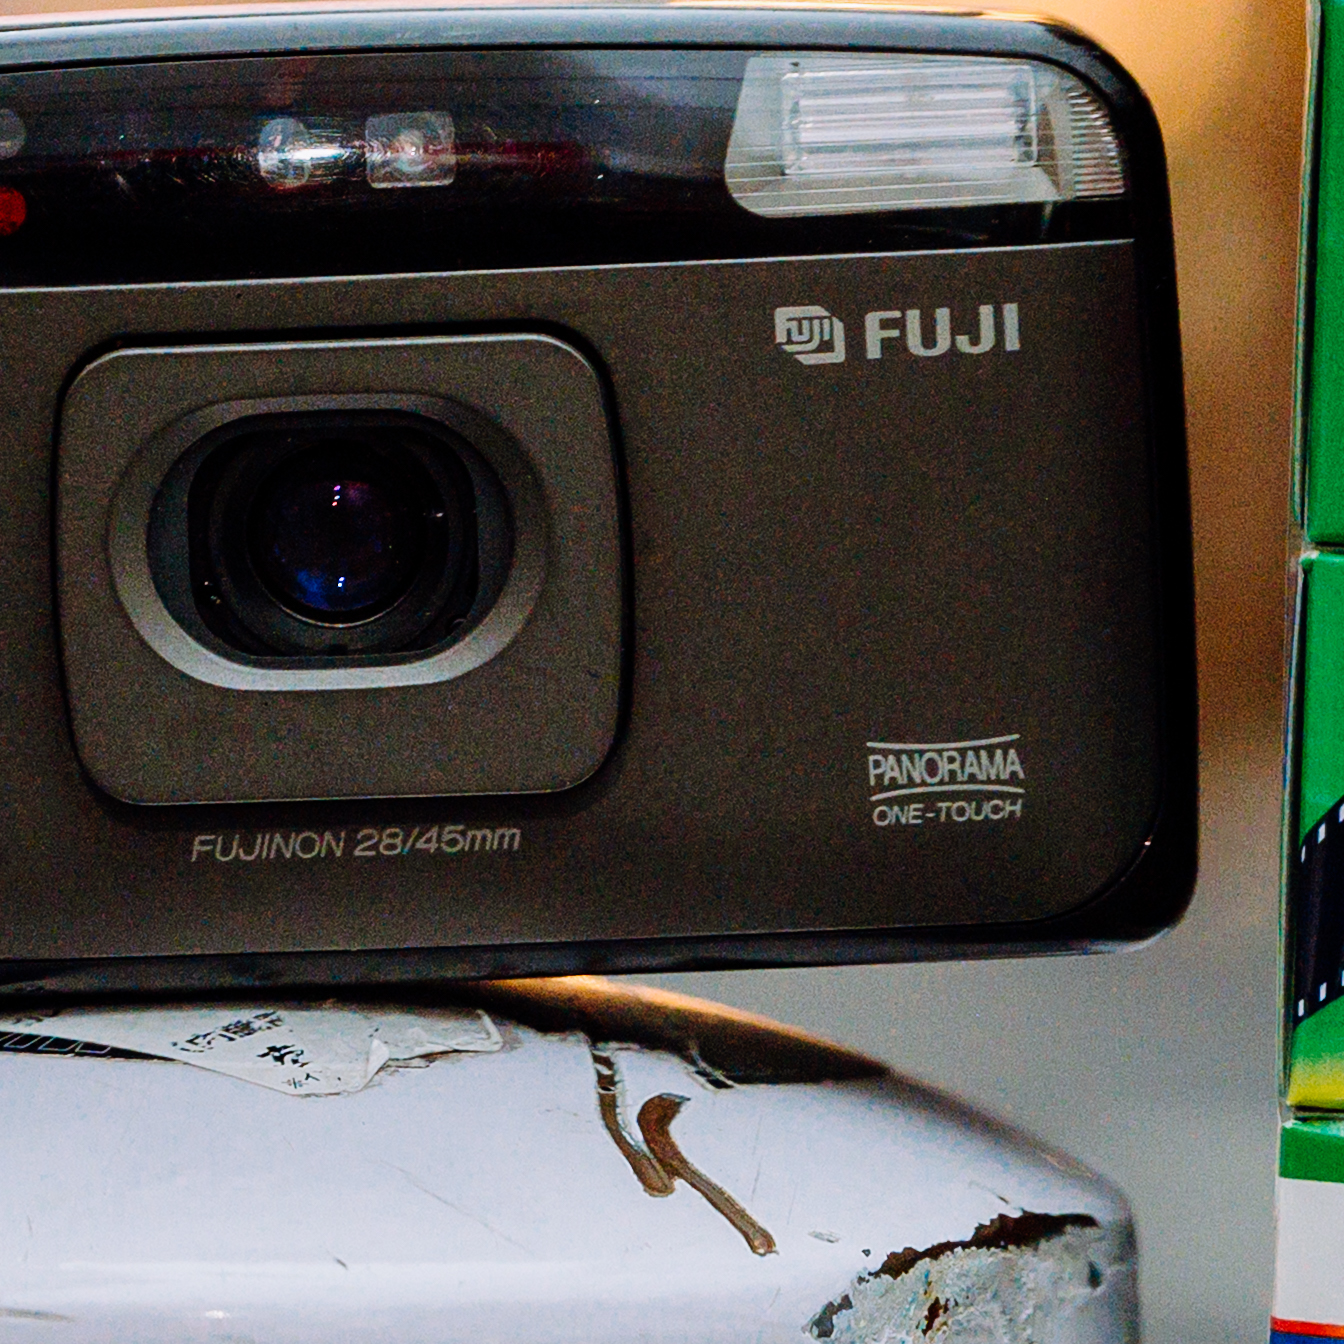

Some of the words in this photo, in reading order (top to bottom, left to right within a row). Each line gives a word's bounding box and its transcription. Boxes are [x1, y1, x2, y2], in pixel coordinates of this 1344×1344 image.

[865, 302, 1021, 360] FUJI
[867, 748, 1026, 787] PANORAMA
[872, 798, 1023, 827] ONE-TOUCH
[190, 830, 347, 863] FUJINON
[353, 824, 523, 857] 28/45mm
